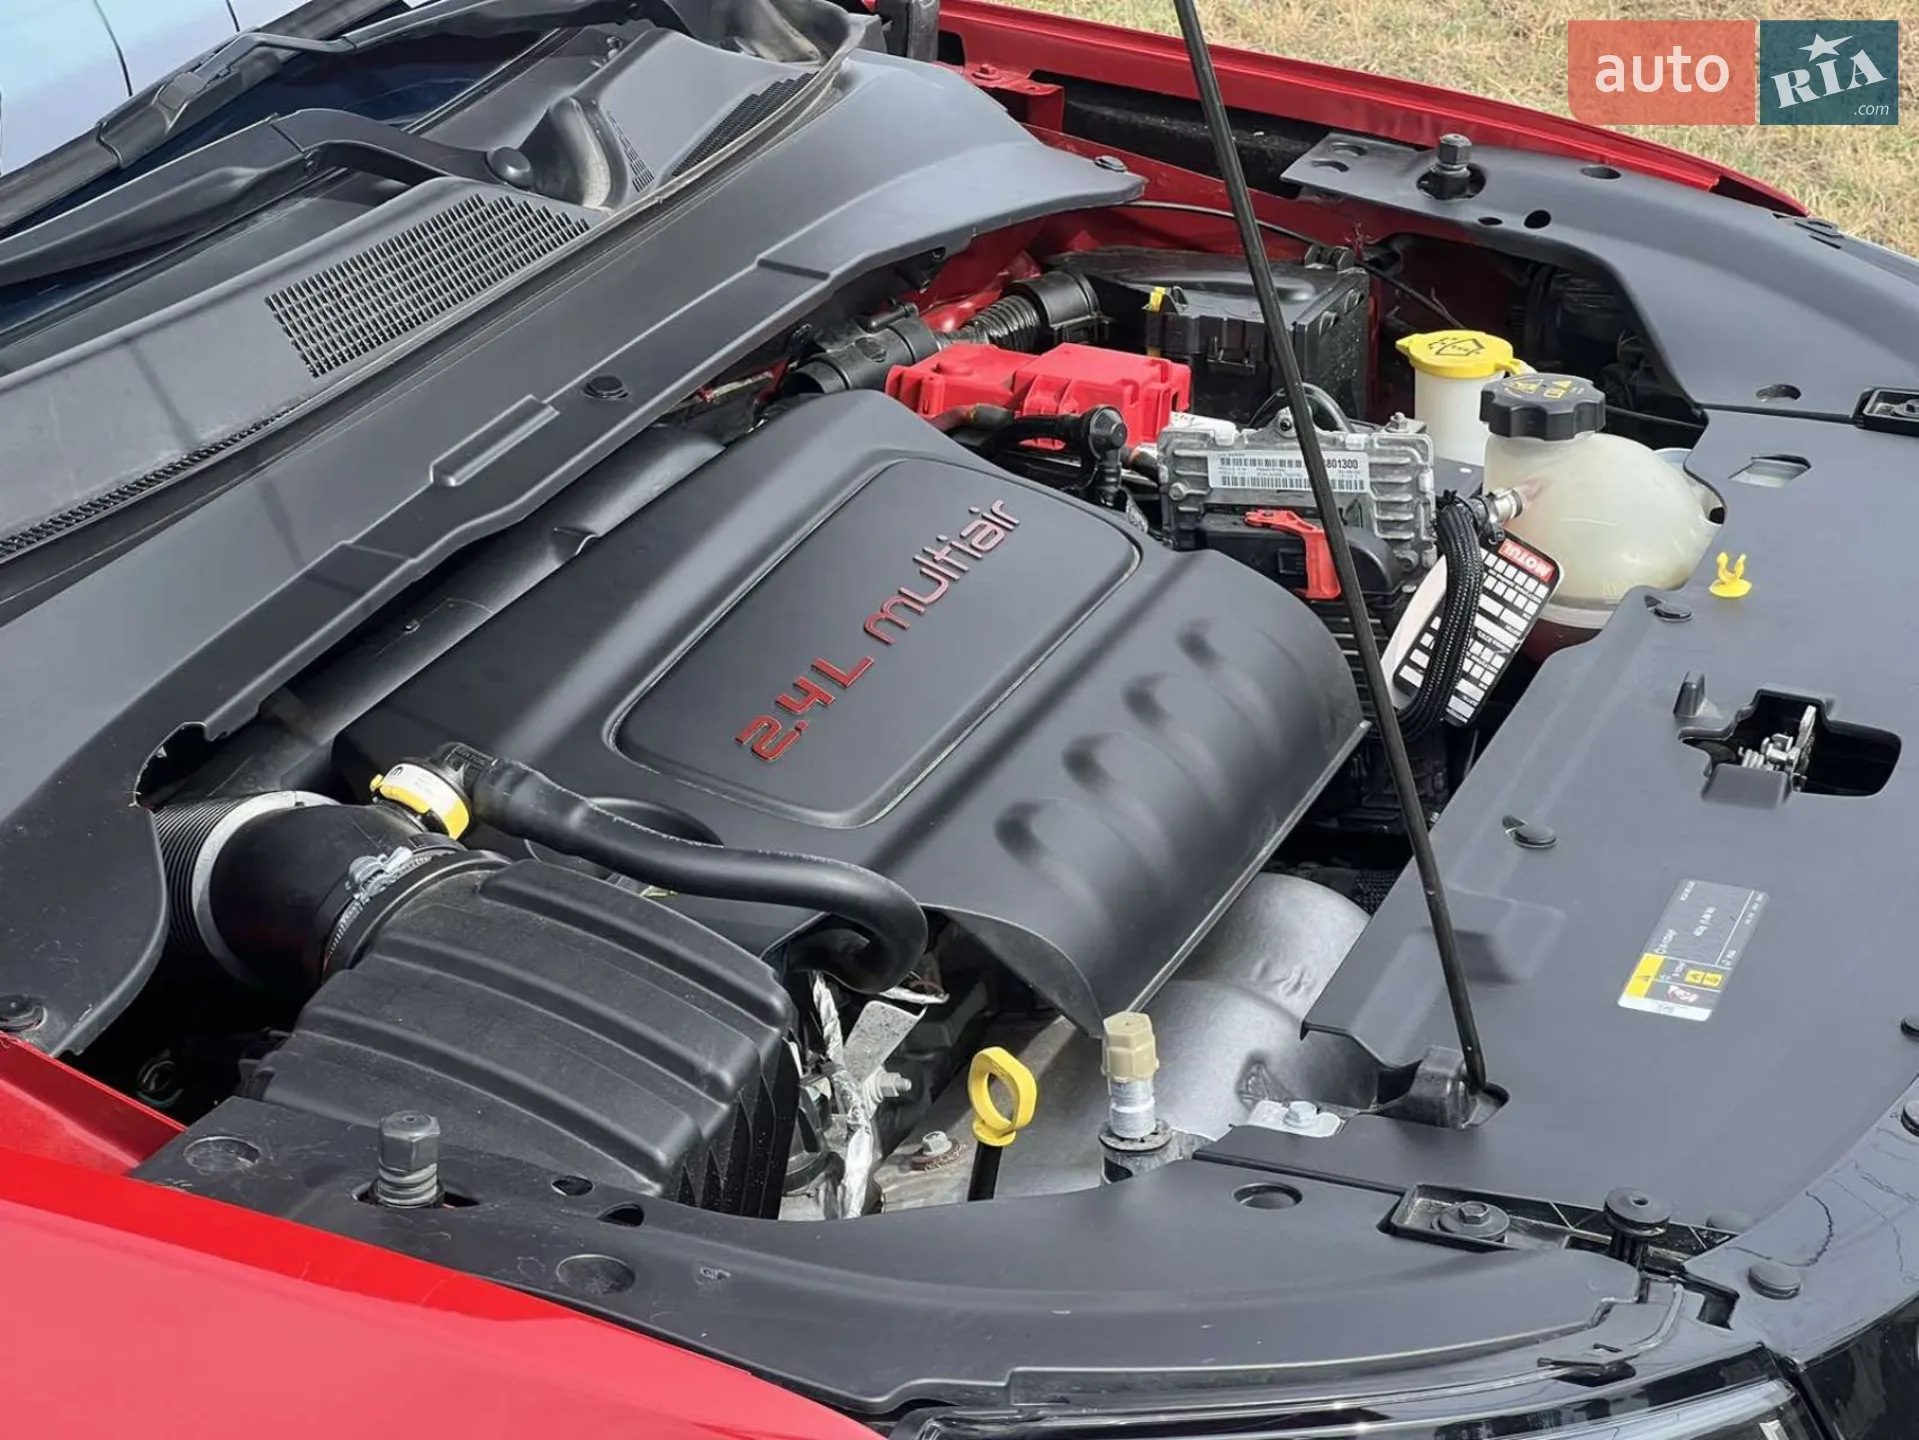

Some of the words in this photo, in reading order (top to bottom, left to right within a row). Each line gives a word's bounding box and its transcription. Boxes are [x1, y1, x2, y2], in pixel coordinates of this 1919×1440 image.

[734, 655, 875, 763] 2.4L
[863, 499, 1020, 646] multiair
[1503, 544, 1553, 577] MOTUL
